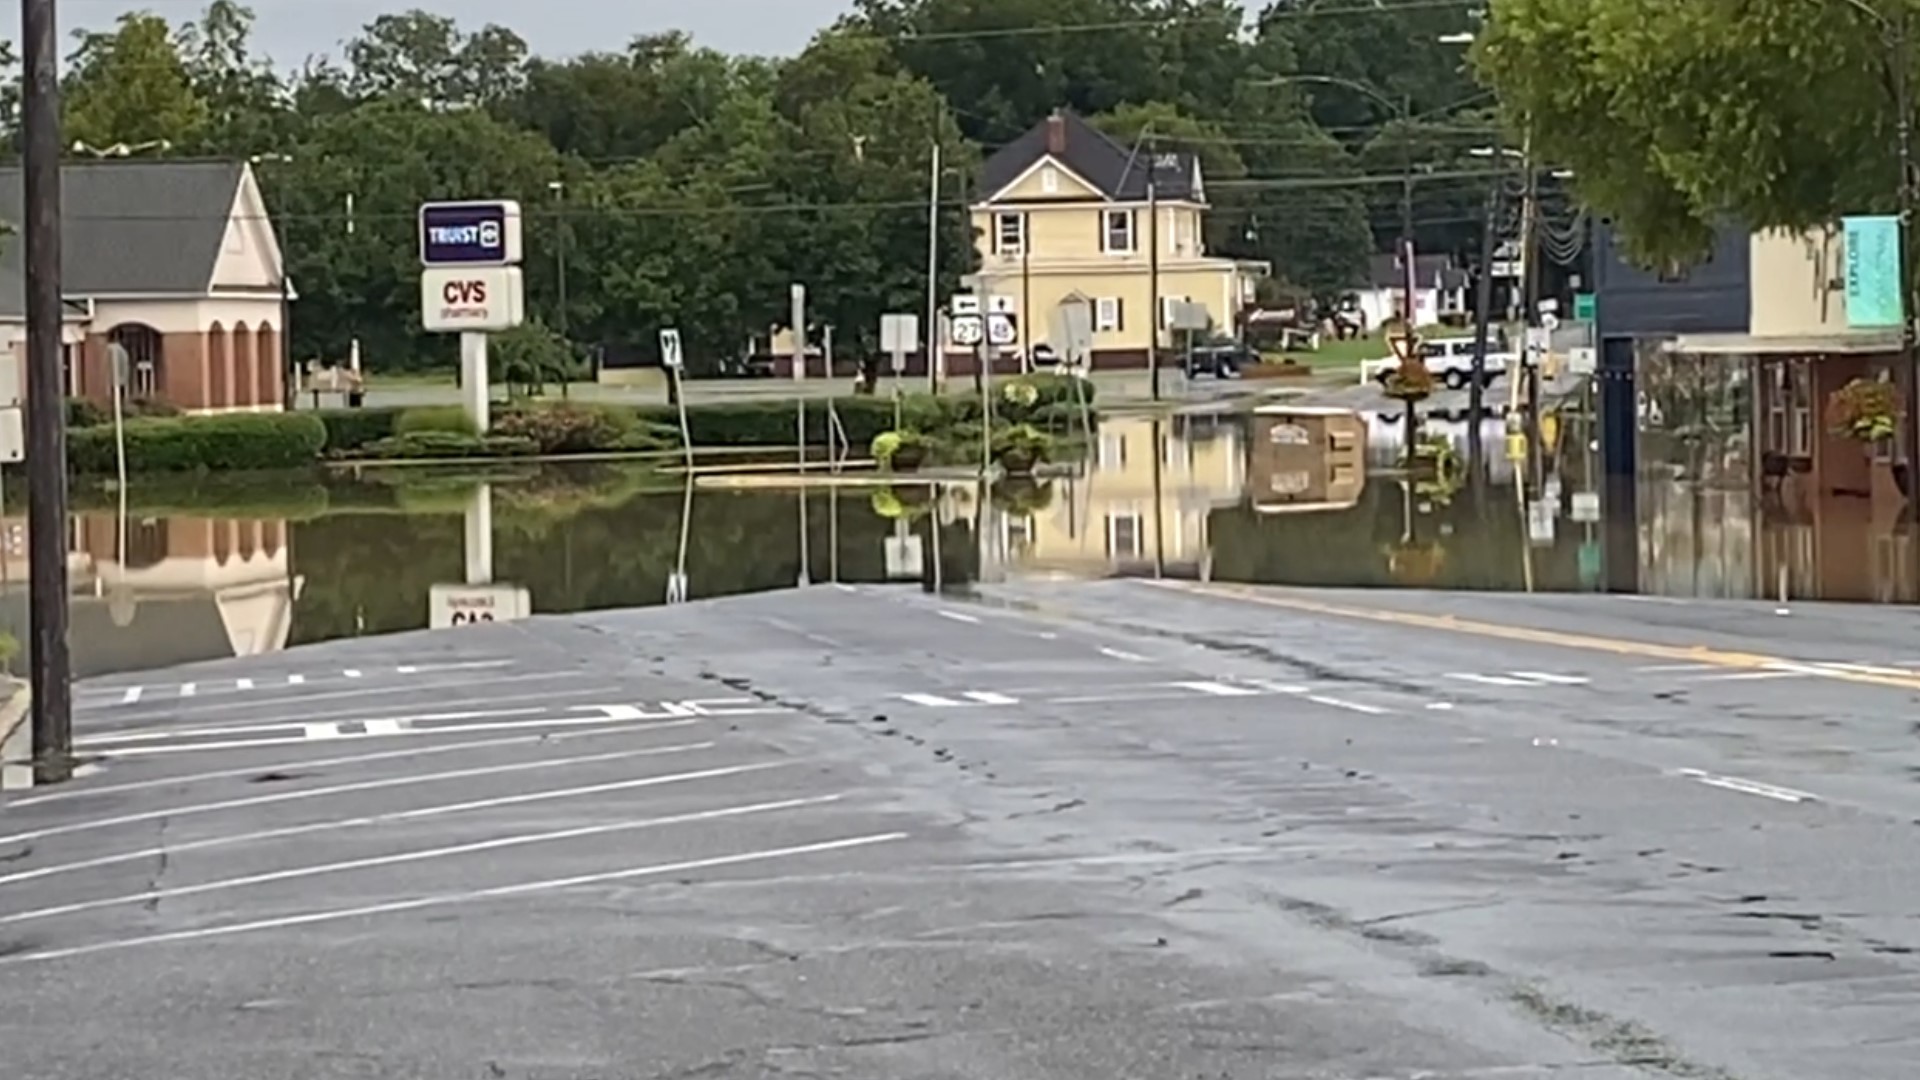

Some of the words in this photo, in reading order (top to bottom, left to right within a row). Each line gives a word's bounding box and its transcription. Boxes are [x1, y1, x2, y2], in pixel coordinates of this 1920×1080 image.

[429, 226, 478, 243] TRUIST
[1847, 231, 1860, 297] EXPLORE
[443, 281, 486, 304] CVS
[957, 322, 979, 340] 27
